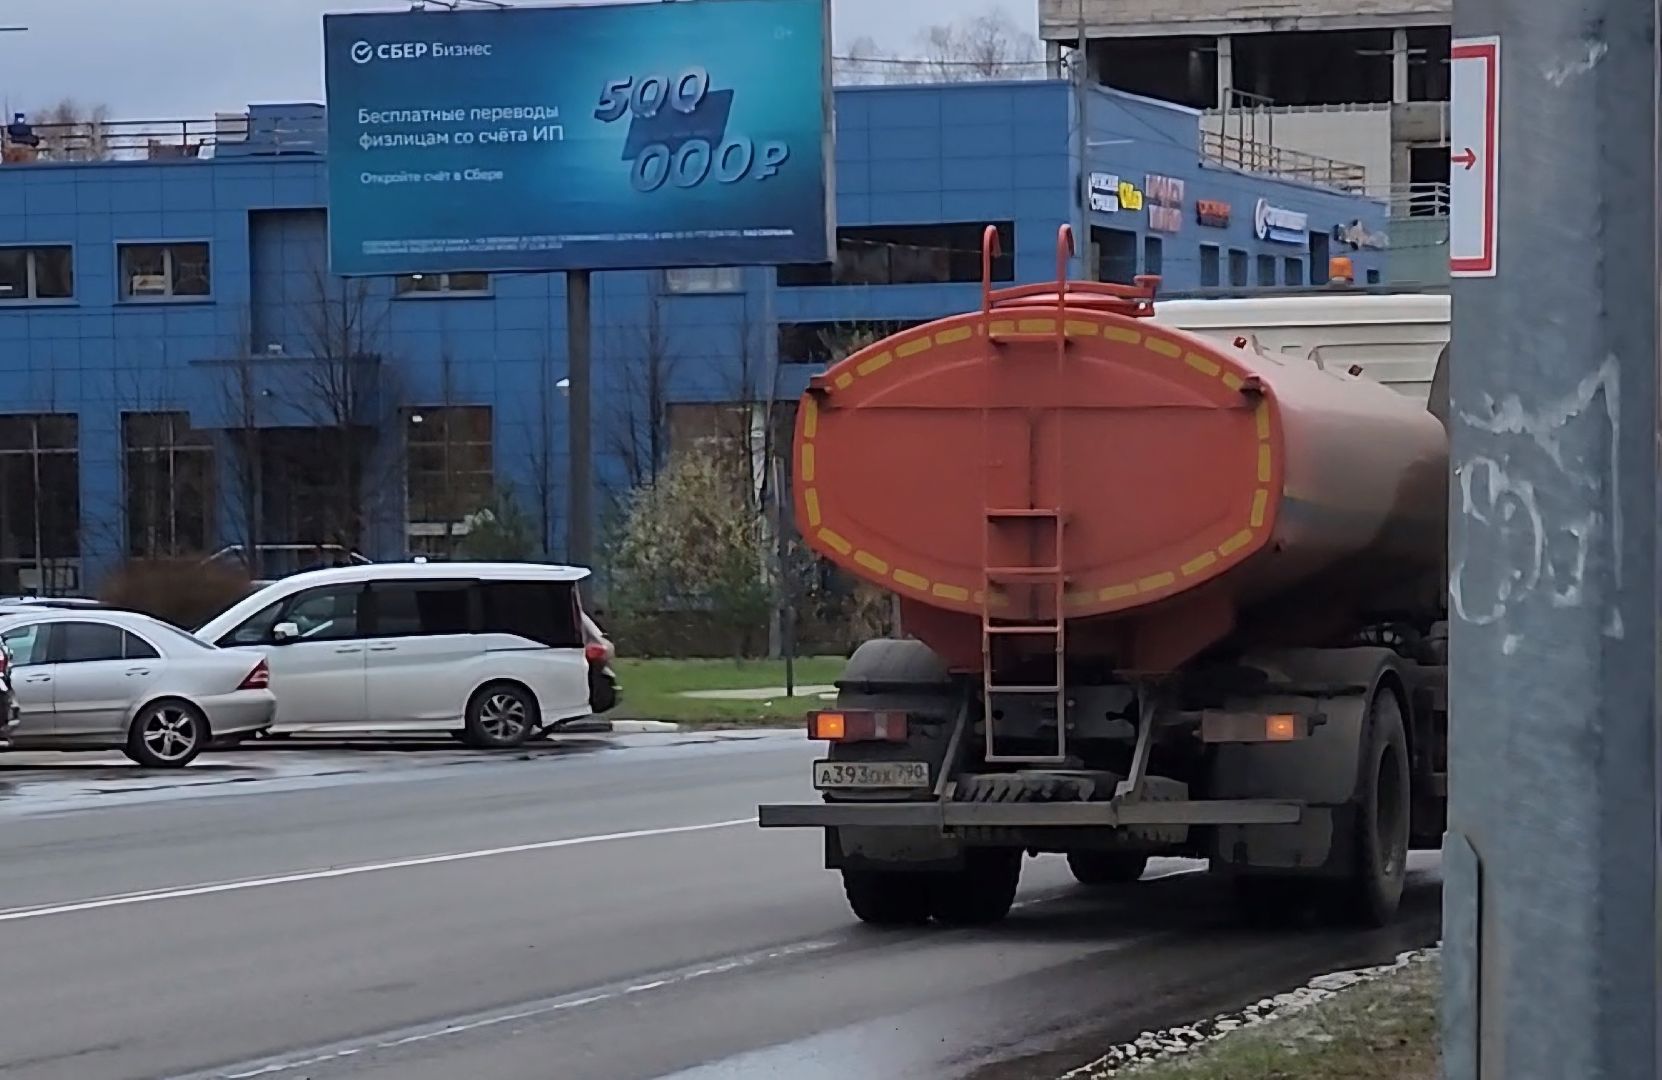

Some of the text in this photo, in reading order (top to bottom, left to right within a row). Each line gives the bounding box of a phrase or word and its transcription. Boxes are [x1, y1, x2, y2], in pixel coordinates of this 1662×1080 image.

[377, 42, 492, 59] СБЕР Бизнес
[594, 65, 710, 122] 500
[358, 105, 559, 124] Бесплатные переводы
[359, 125, 564, 150] физлицам со счёта ИП
[360, 170, 421, 185] Откройте
[454, 171, 462, 181] в
[464, 168, 504, 182] Сбере
